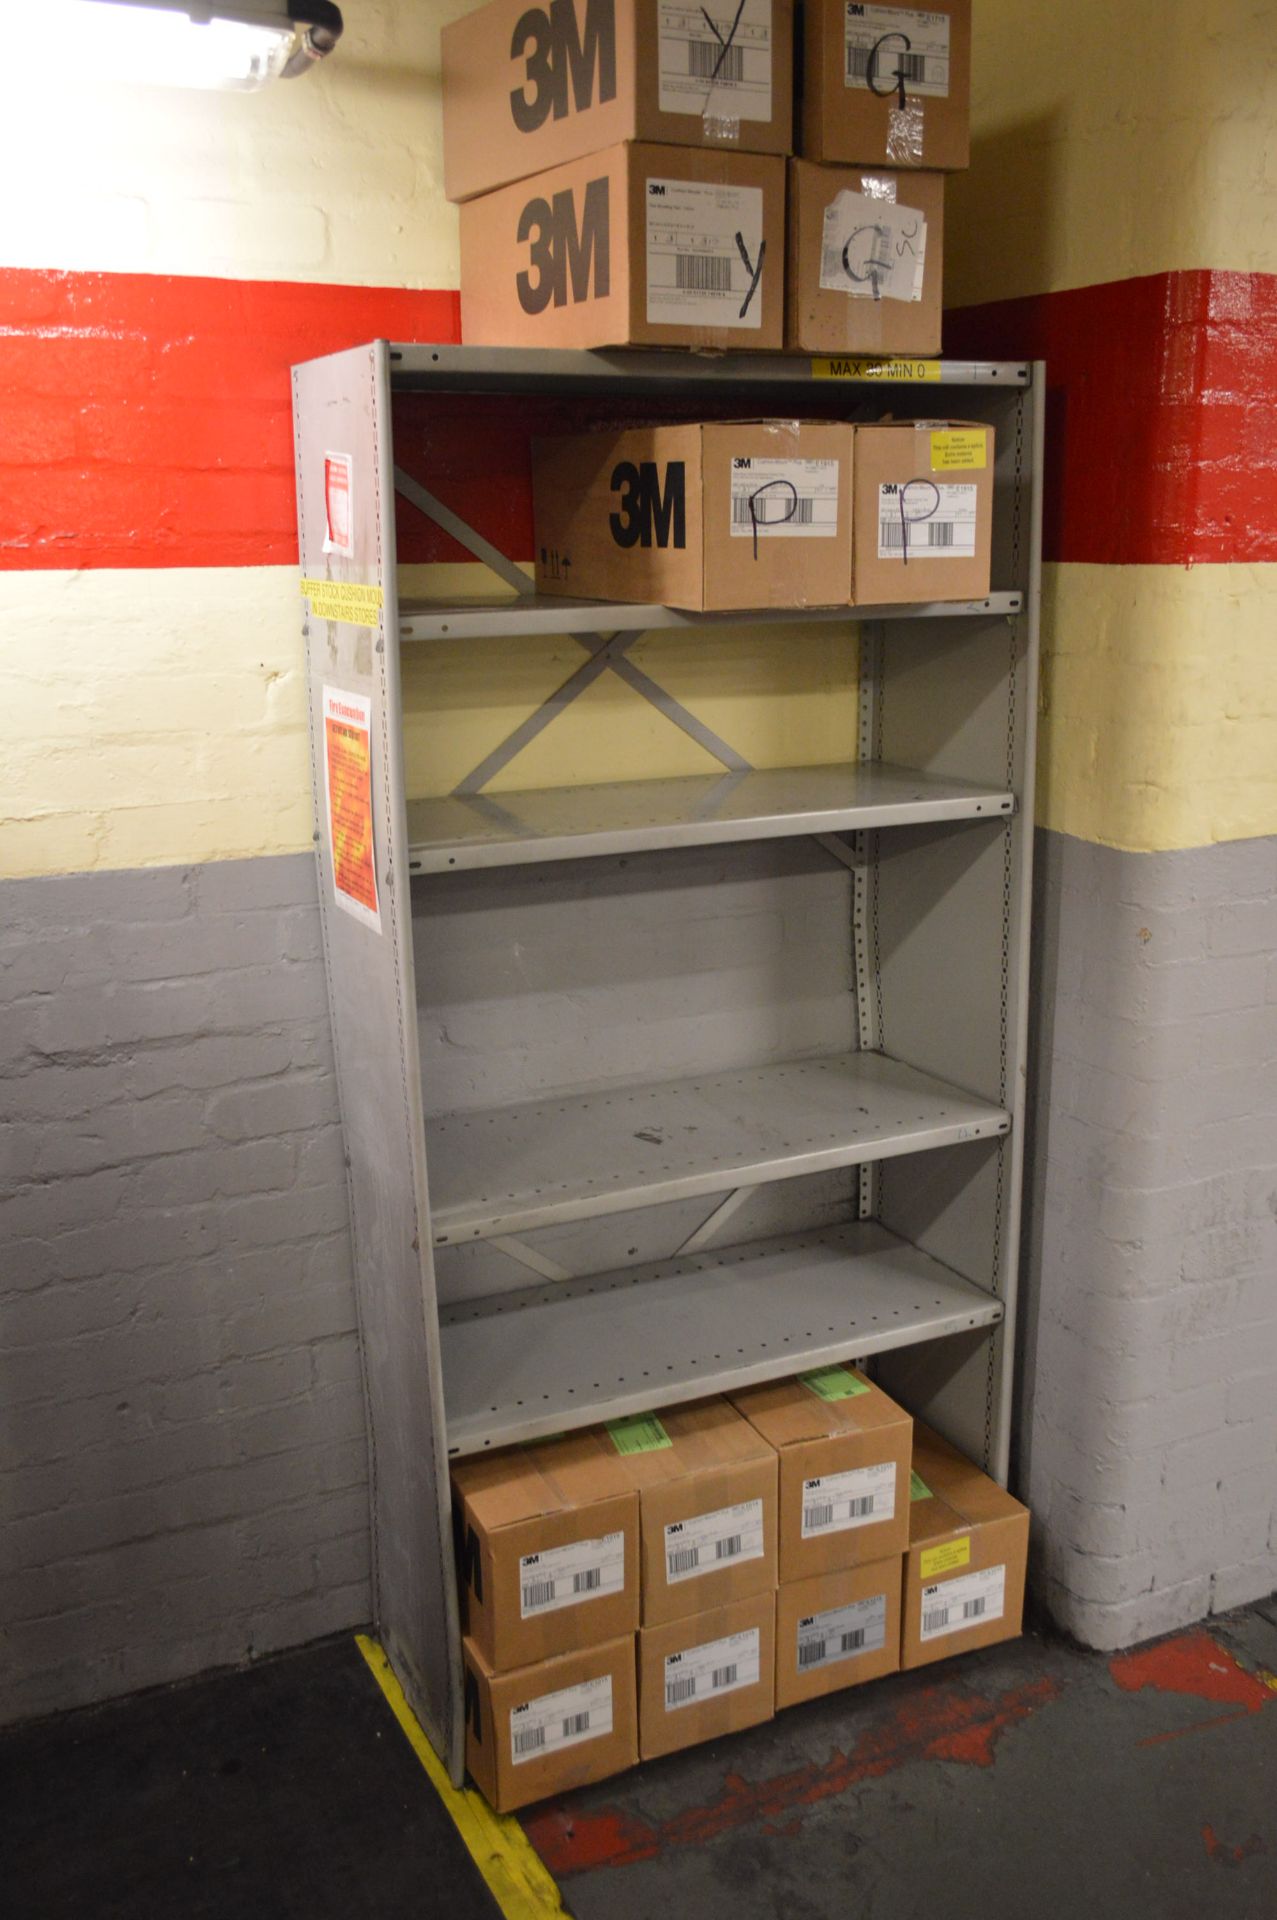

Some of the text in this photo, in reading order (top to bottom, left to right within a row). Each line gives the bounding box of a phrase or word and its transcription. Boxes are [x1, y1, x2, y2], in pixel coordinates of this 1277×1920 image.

[847, 4, 864, 17] 3M
[510, 0, 616, 133] 3M
[866, 32, 912, 110] G
[649, 184, 666, 196] 3M
[516, 176, 610, 315] 3M
[830, 361, 861, 377] MAX
[888, 363, 912, 378] MIN
[733, 457, 751, 469] 3M
[882, 484, 897, 495] 3M
[609, 461, 686, 549] 3M
[749, 480, 798, 561] P
[899, 478, 941, 565] P
[354, 608, 377, 625] STORES
[805, 1479, 820, 1489] 3M
[667, 1523, 683, 1535] 3M
[522, 1555, 539, 1566] 3M
